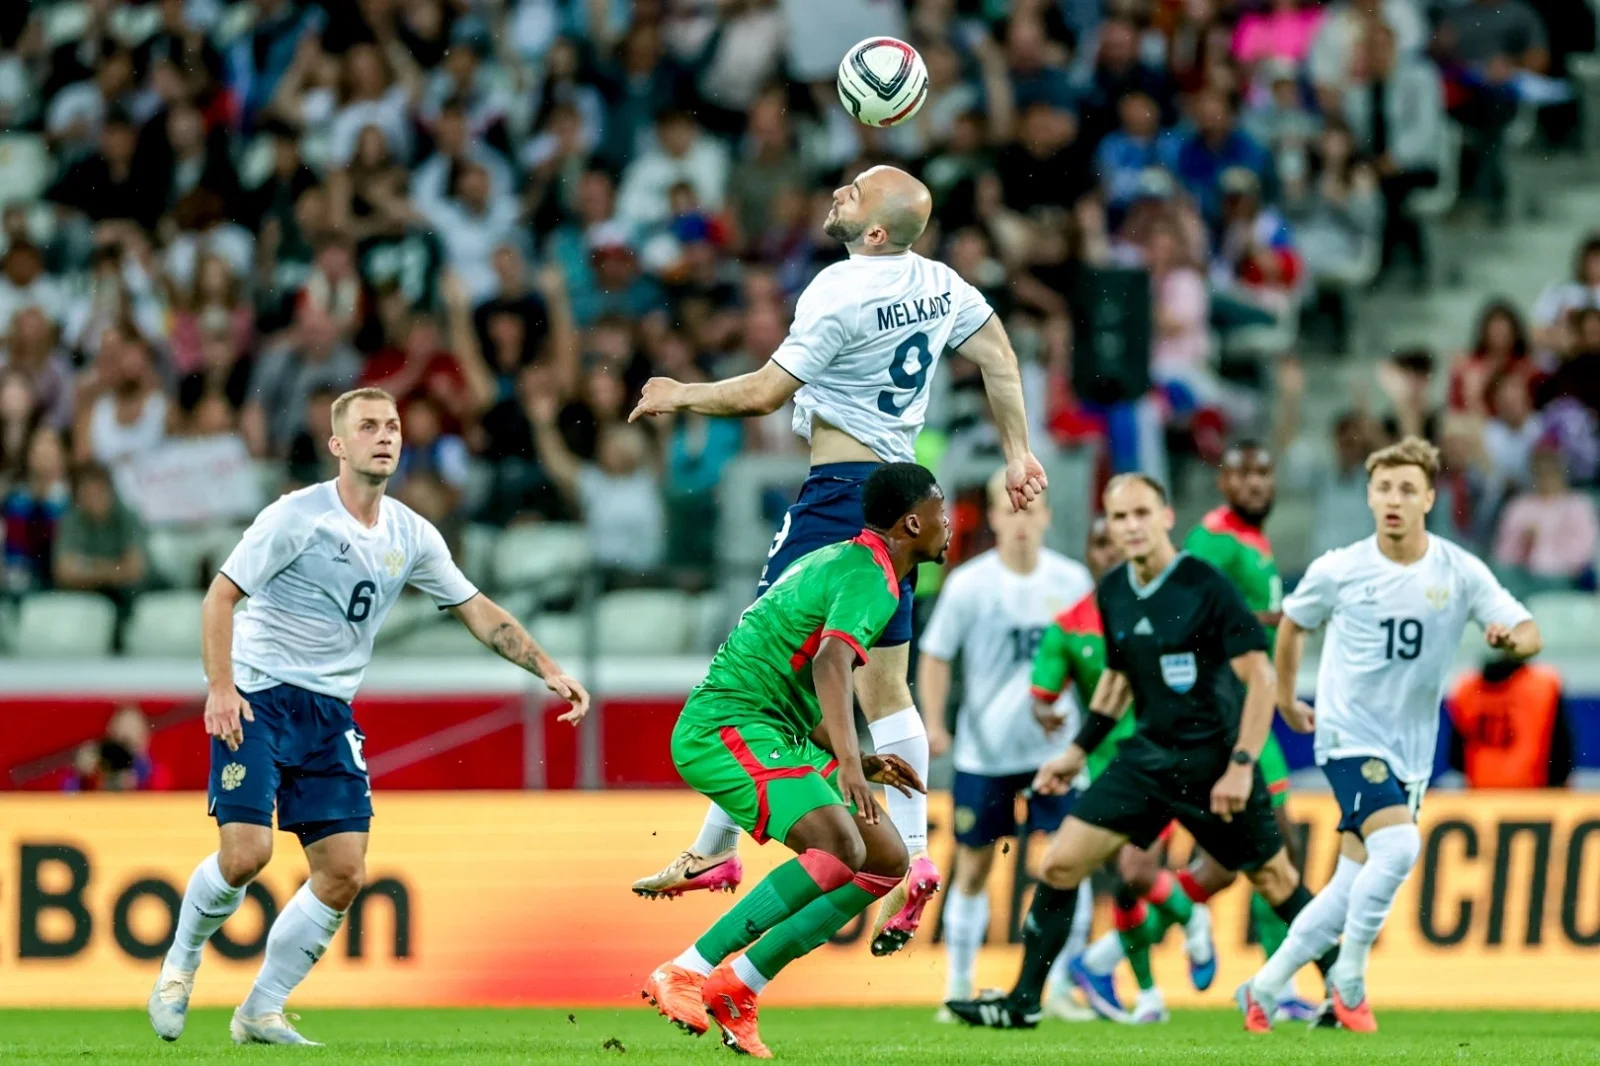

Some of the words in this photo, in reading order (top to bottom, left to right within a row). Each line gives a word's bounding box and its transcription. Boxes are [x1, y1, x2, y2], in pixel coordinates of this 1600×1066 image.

[877, 331, 933, 418] 9
[347, 580, 376, 622] 6
[1379, 617, 1423, 660] 19
